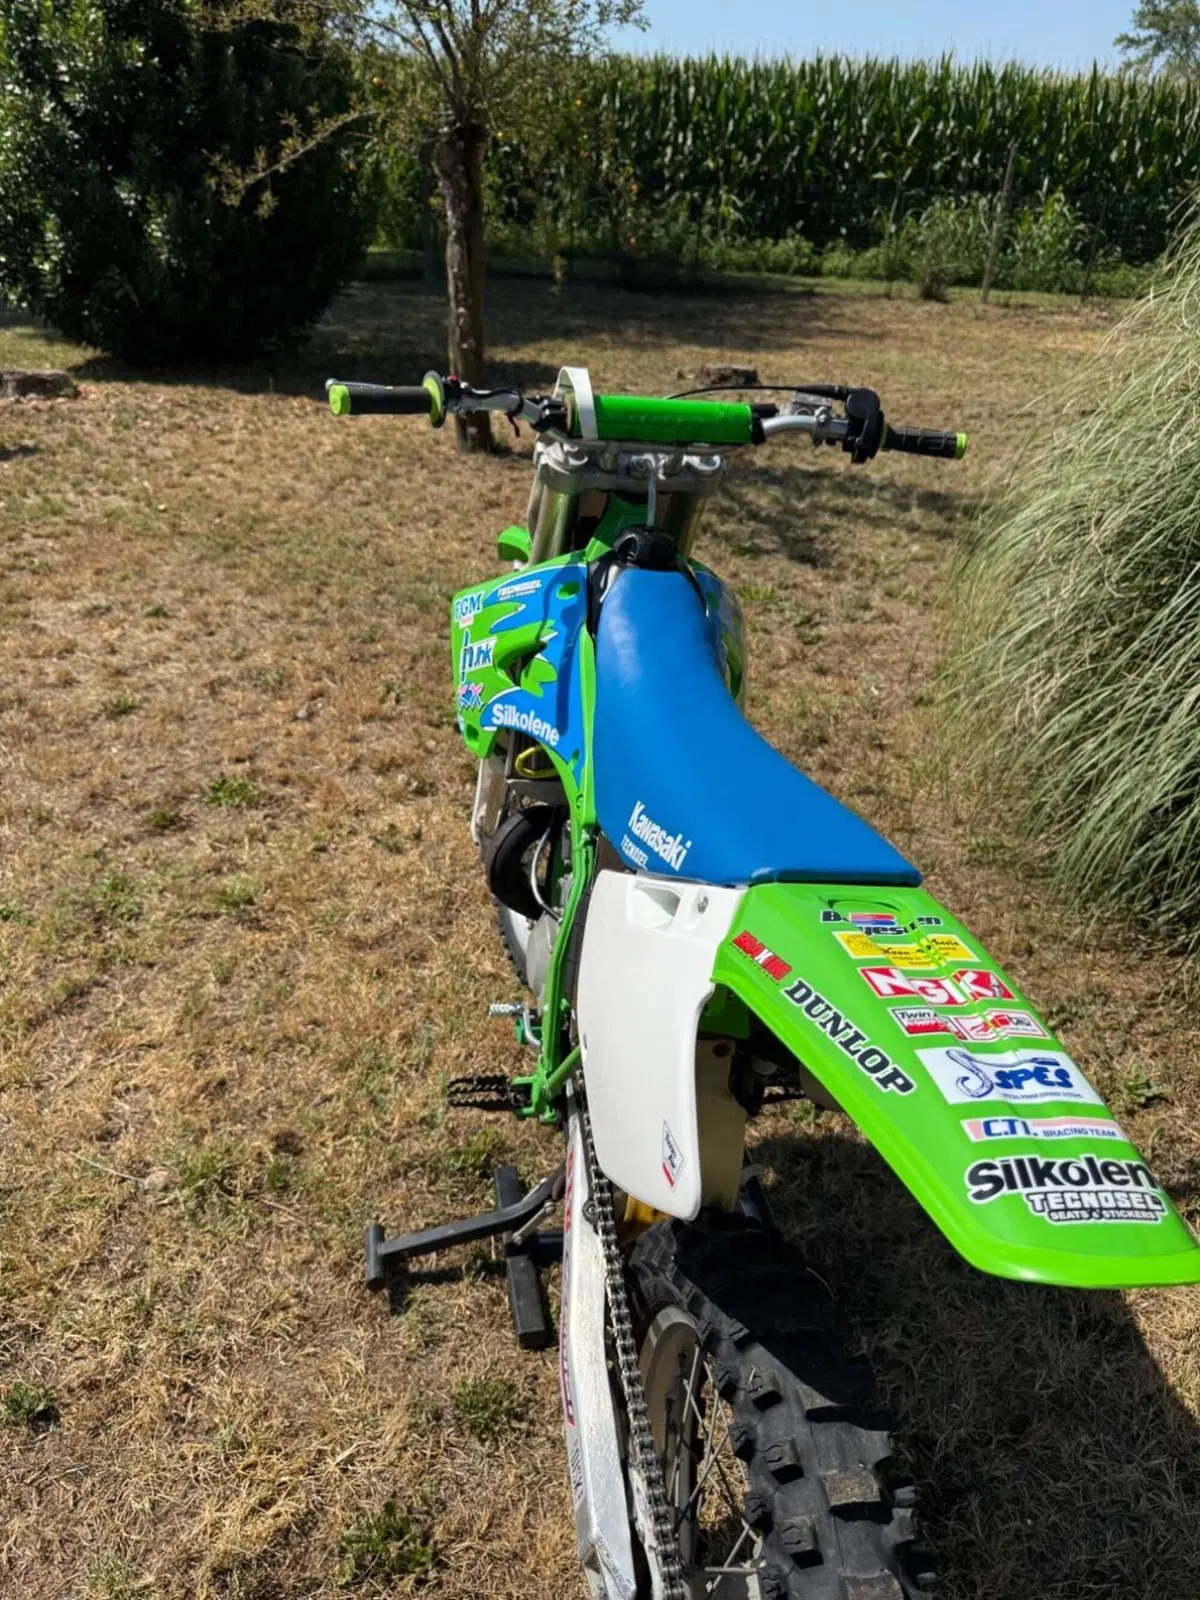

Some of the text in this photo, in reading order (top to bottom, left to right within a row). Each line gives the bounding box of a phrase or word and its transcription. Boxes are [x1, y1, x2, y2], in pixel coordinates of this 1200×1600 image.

[491, 702, 560, 747] Silkolene
[628, 800, 692, 872] Kawasaki
[784, 979, 914, 1094] DUNLOP
[1089, 1128, 1117, 1138] TEAM
[1027, 1191, 1163, 1212] TECNOSEL
[1050, 1210, 1088, 1220] SEATS
[1102, 1210, 1155, 1221] STICKERS
